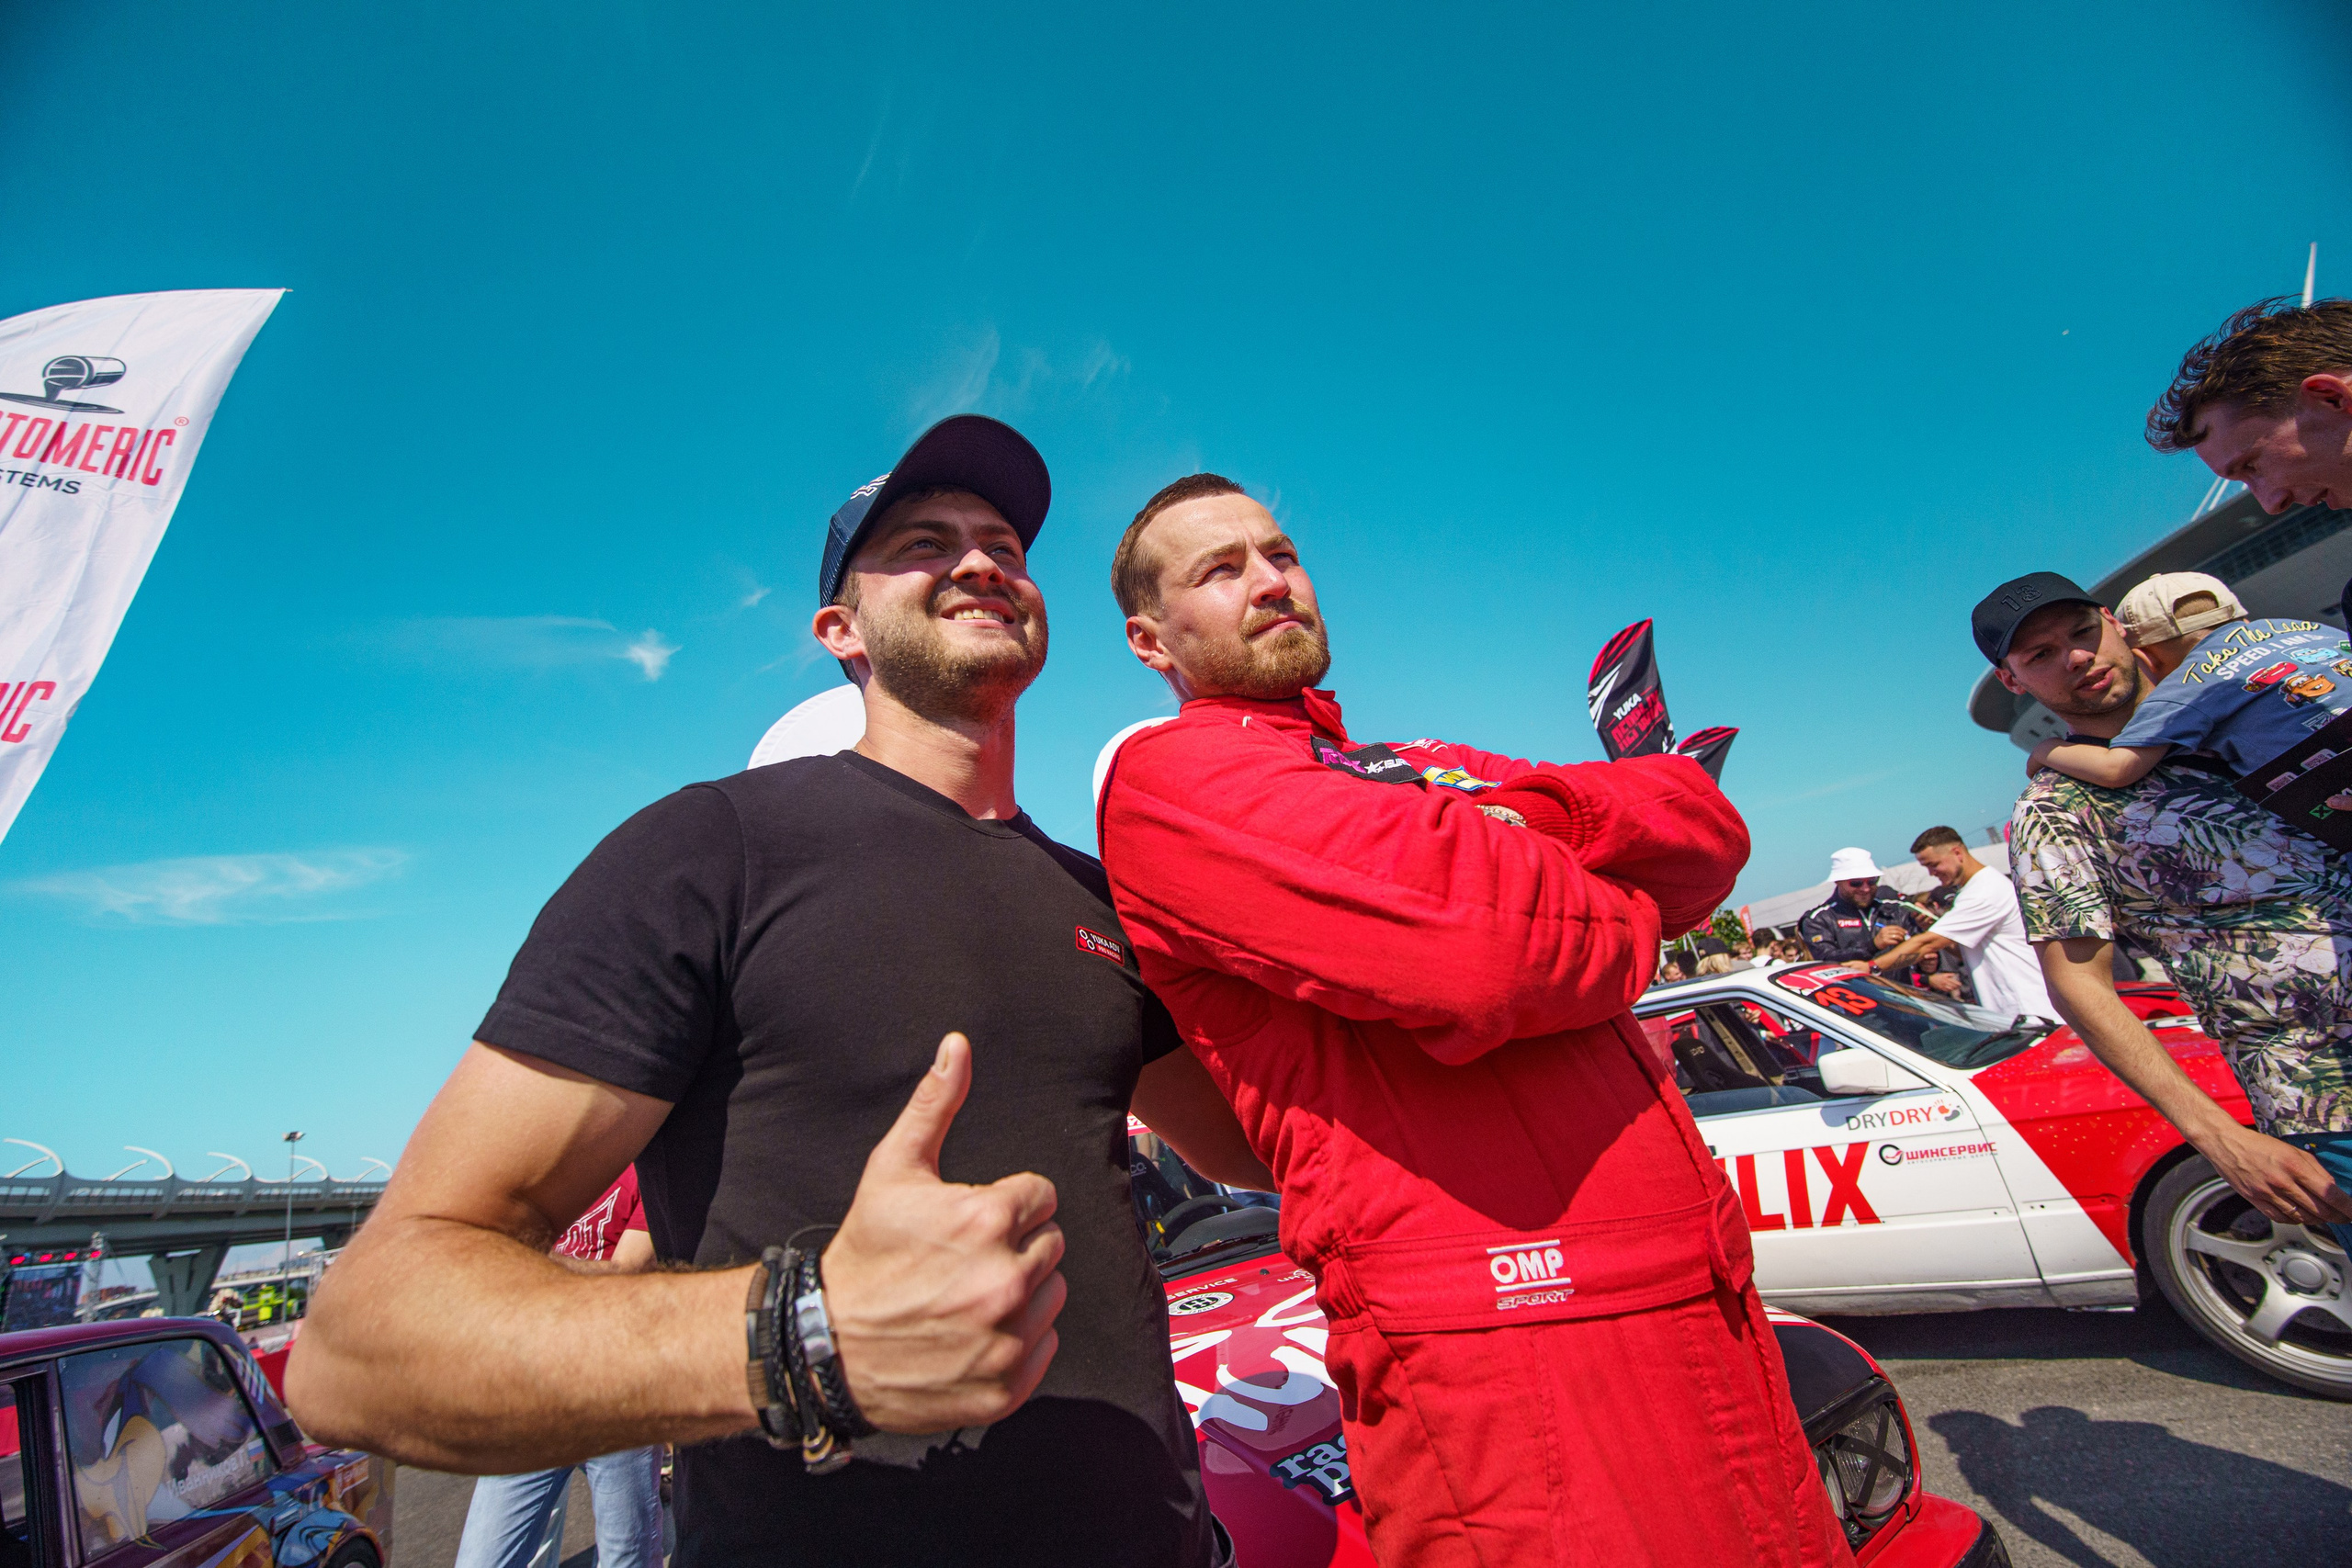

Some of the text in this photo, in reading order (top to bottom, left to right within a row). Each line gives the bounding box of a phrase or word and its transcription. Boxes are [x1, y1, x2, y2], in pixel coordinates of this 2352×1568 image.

[0, 410, 176, 486] TOMERIC
[2001, 585, 2042, 612] 13
[2182, 647, 2239, 683] Take
[2224, 626, 2273, 647] The
[1613, 693, 1642, 720] YUKA
[1090, 933, 1109, 948] YUKA
[1815, 987, 1877, 1015] 13
[1905, 1142, 1997, 1161] ШИНСЕРВИС
[1714, 1141, 1882, 1232] LIX
[1490, 1248, 1564, 1284] OMP
[1497, 1289, 1575, 1310] SPORT
